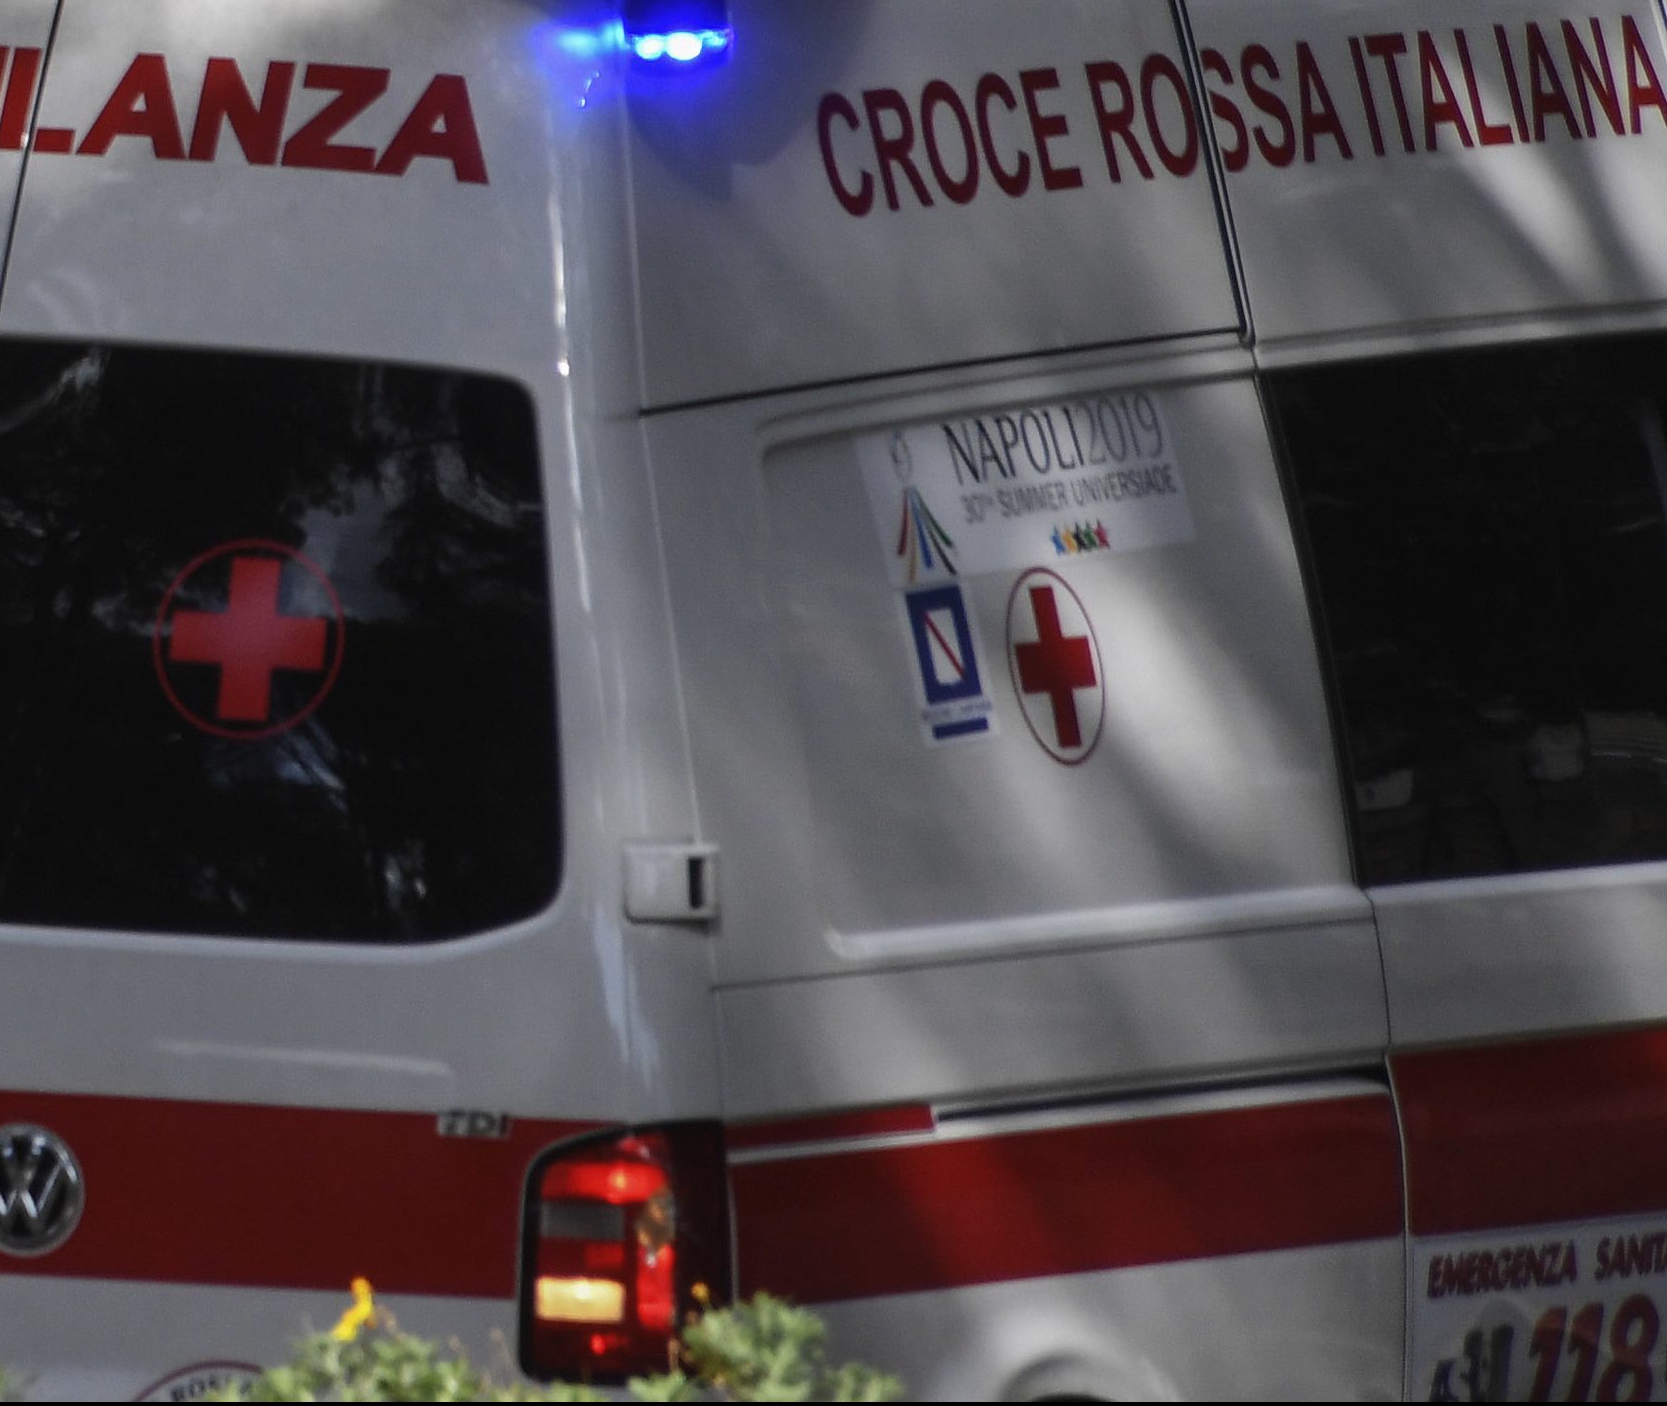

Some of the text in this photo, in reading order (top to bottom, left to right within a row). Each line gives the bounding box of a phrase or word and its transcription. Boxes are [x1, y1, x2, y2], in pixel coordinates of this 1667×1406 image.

[815, 14, 1667, 219] CROCE ROSSA ITALIANA
[1427, 1240, 1577, 1298] EMERGENZA
[1528, 1293, 1661, 1401] 118
